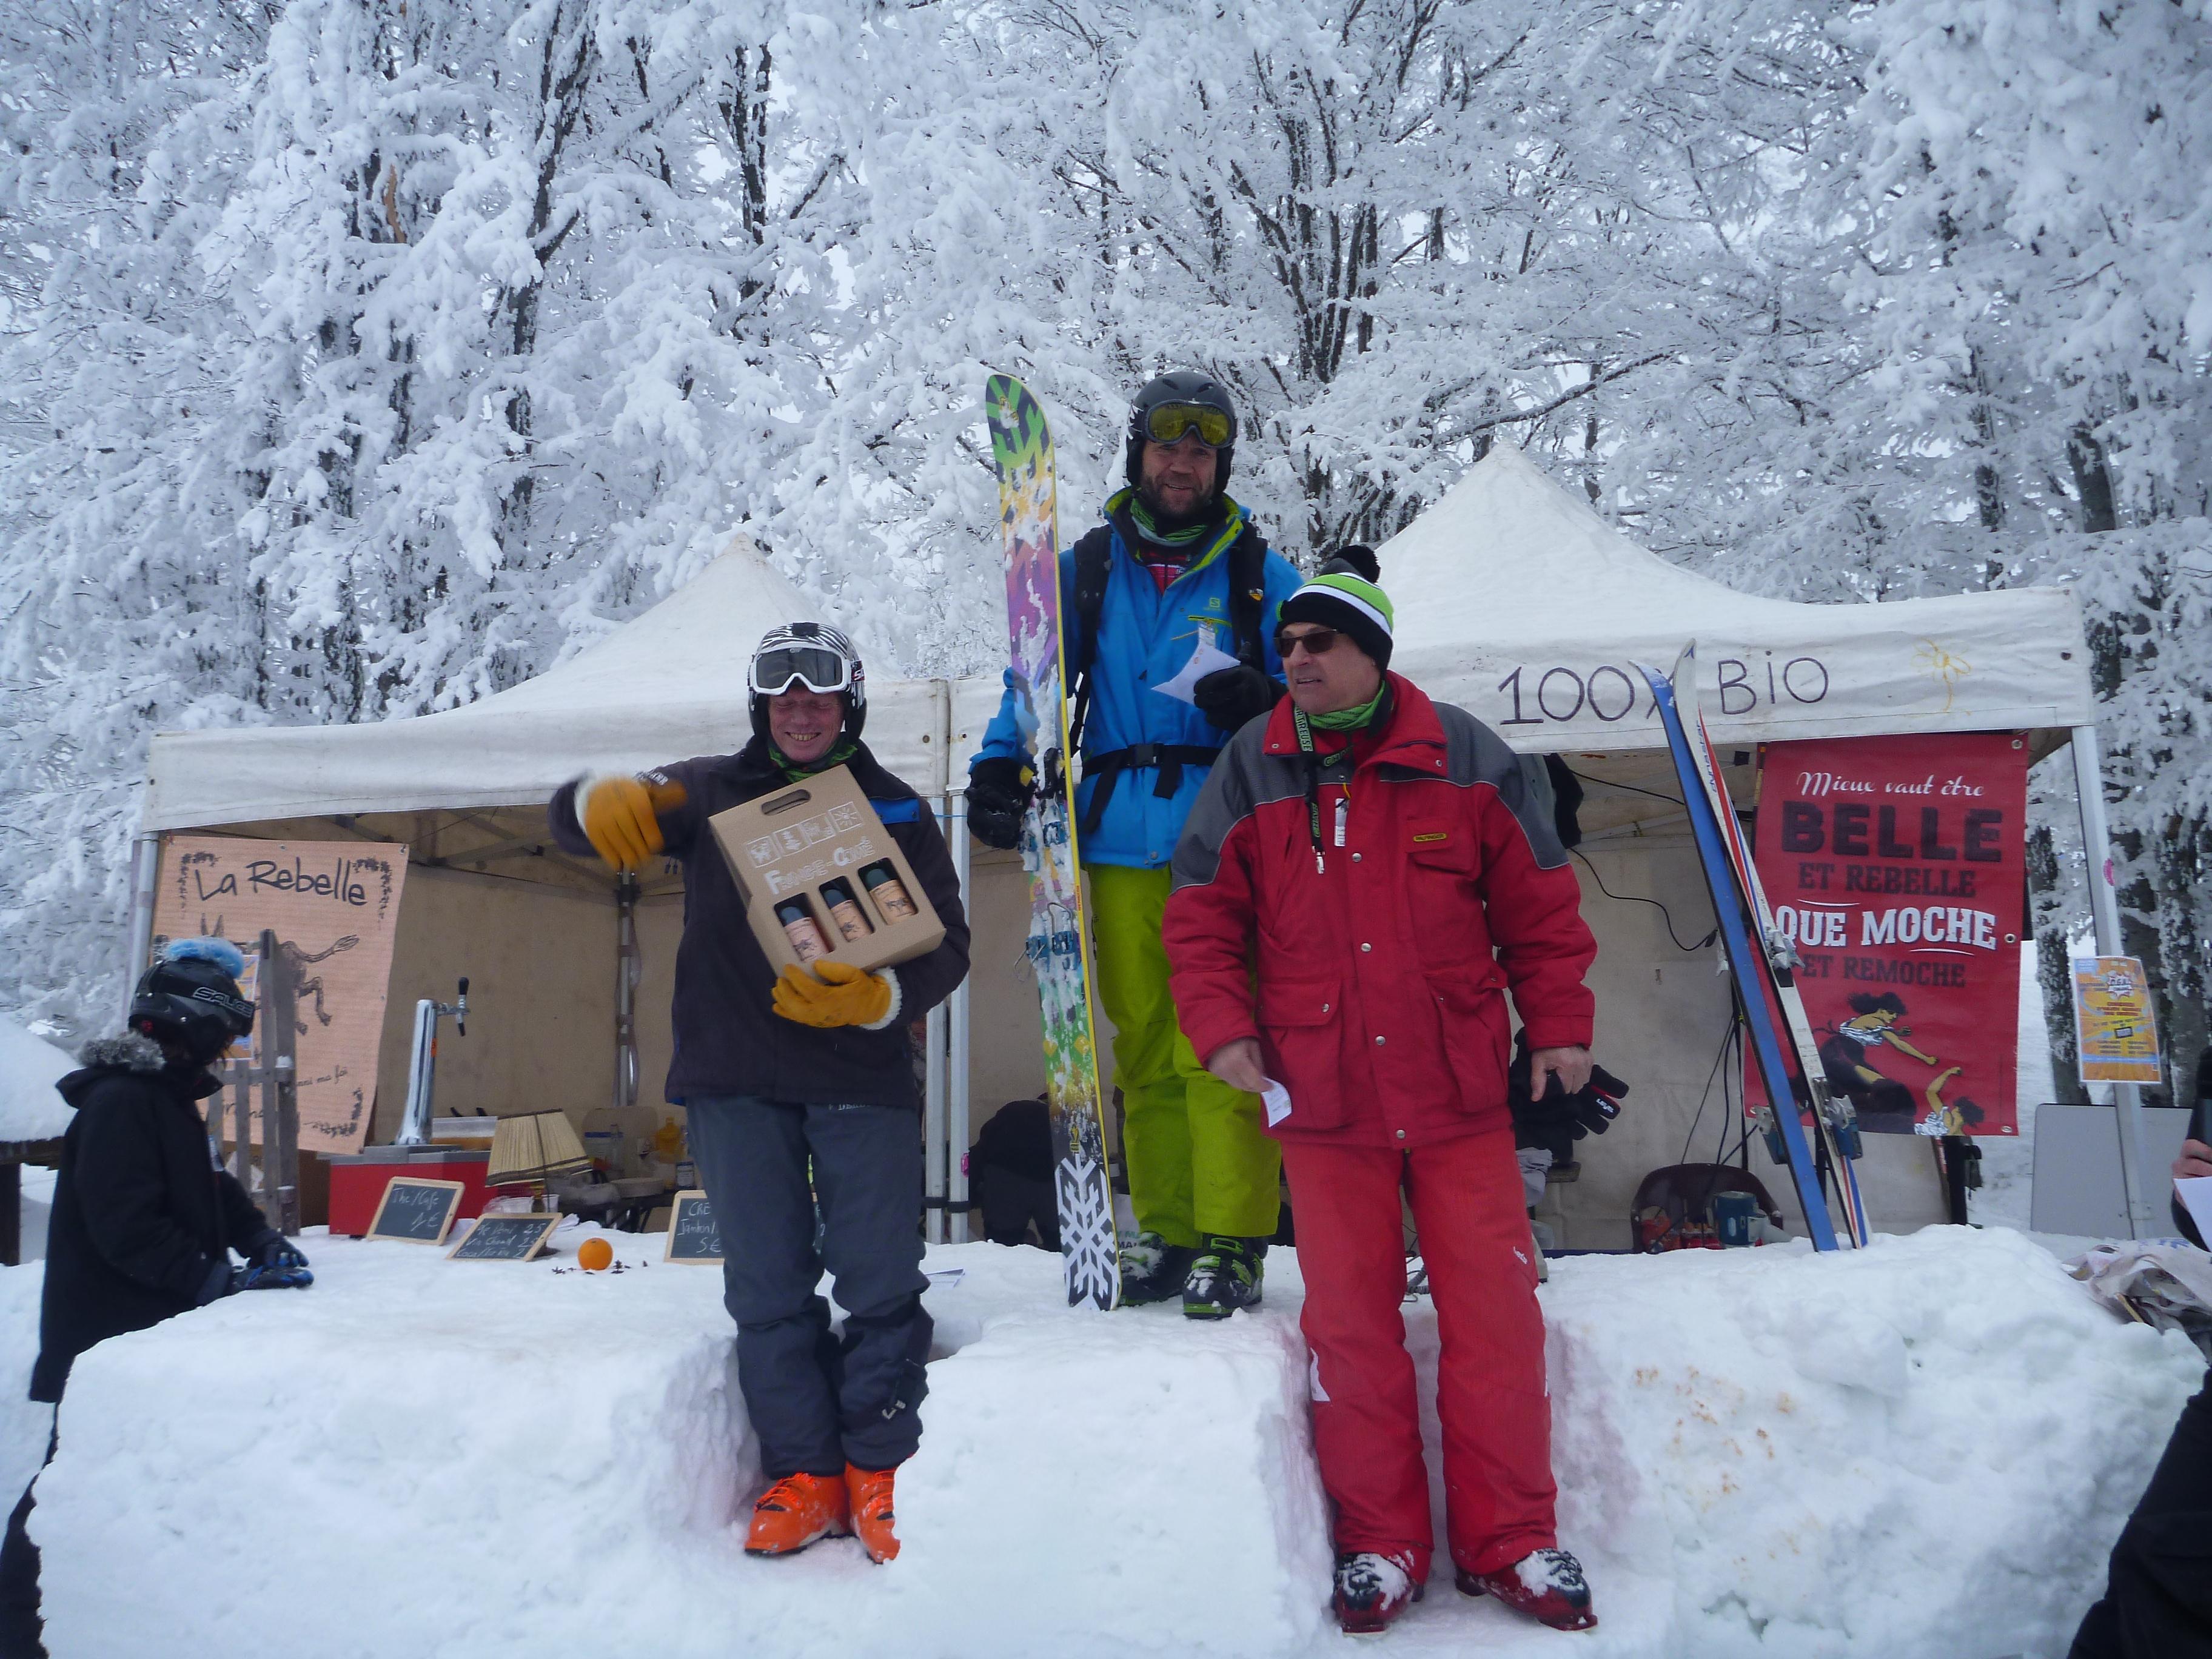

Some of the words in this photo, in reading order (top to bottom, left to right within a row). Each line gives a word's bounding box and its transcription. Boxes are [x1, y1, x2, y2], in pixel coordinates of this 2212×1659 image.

[1796, 771, 1877, 797] Mieux
[1885, 774, 1934, 797] vaut
[1941, 774, 1985, 797] être
[1781, 800, 2003, 862] BELLE
[194, 868, 238, 902] La
[246, 857, 367, 906] Rebelle
[1797, 862, 1835, 890] ET
[1845, 865, 1976, 897] REBELLE
[1777, 905, 1847, 948] QUE
[1860, 906, 1997, 951] MOCHE
[1801, 954, 1832, 979] ET
[1843, 956, 1966, 988] REMOCHE
[688, 1201, 711, 1216] CRE
[677, 1218, 717, 1236] Jambon/
